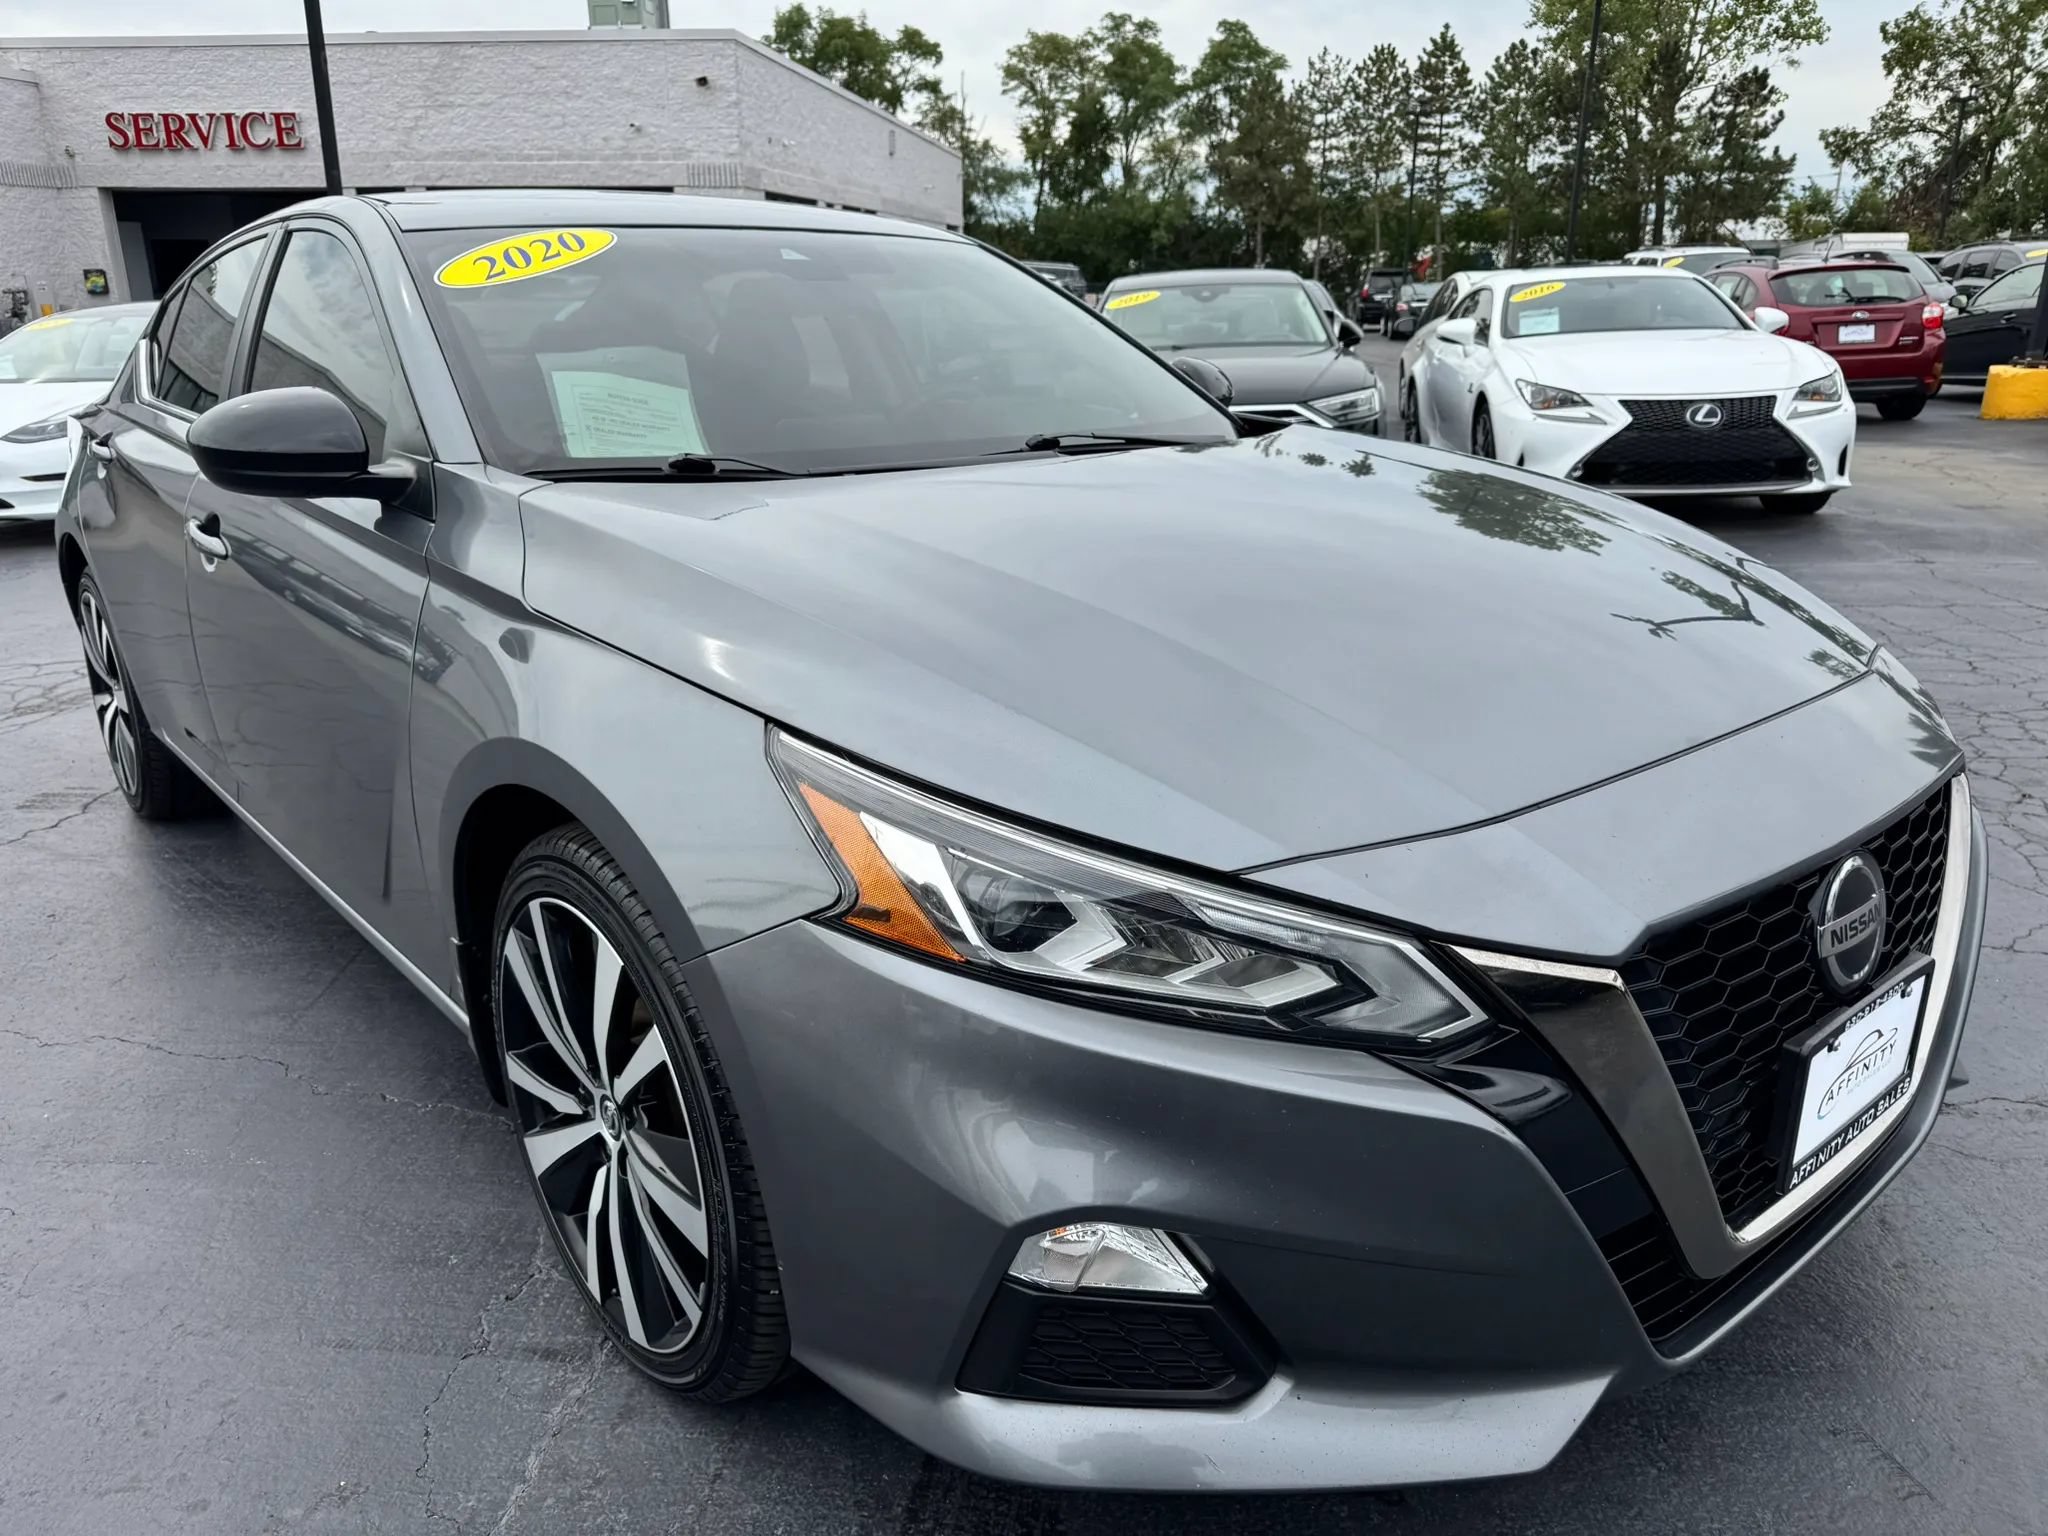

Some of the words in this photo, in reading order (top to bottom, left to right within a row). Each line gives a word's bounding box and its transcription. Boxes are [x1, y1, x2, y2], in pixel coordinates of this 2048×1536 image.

[104, 111, 304, 150] SERVICE
[472, 231, 586, 281] 2020
[1523, 284, 1556, 299] 2016
[1830, 902, 1881, 949] NISSAN
[1825, 1039, 1897, 1106] AFFINITY
[1789, 1132, 1845, 1190] AFFINITY
[1844, 1107, 1876, 1144] AUTO
[1875, 1077, 1911, 1117] SALES
